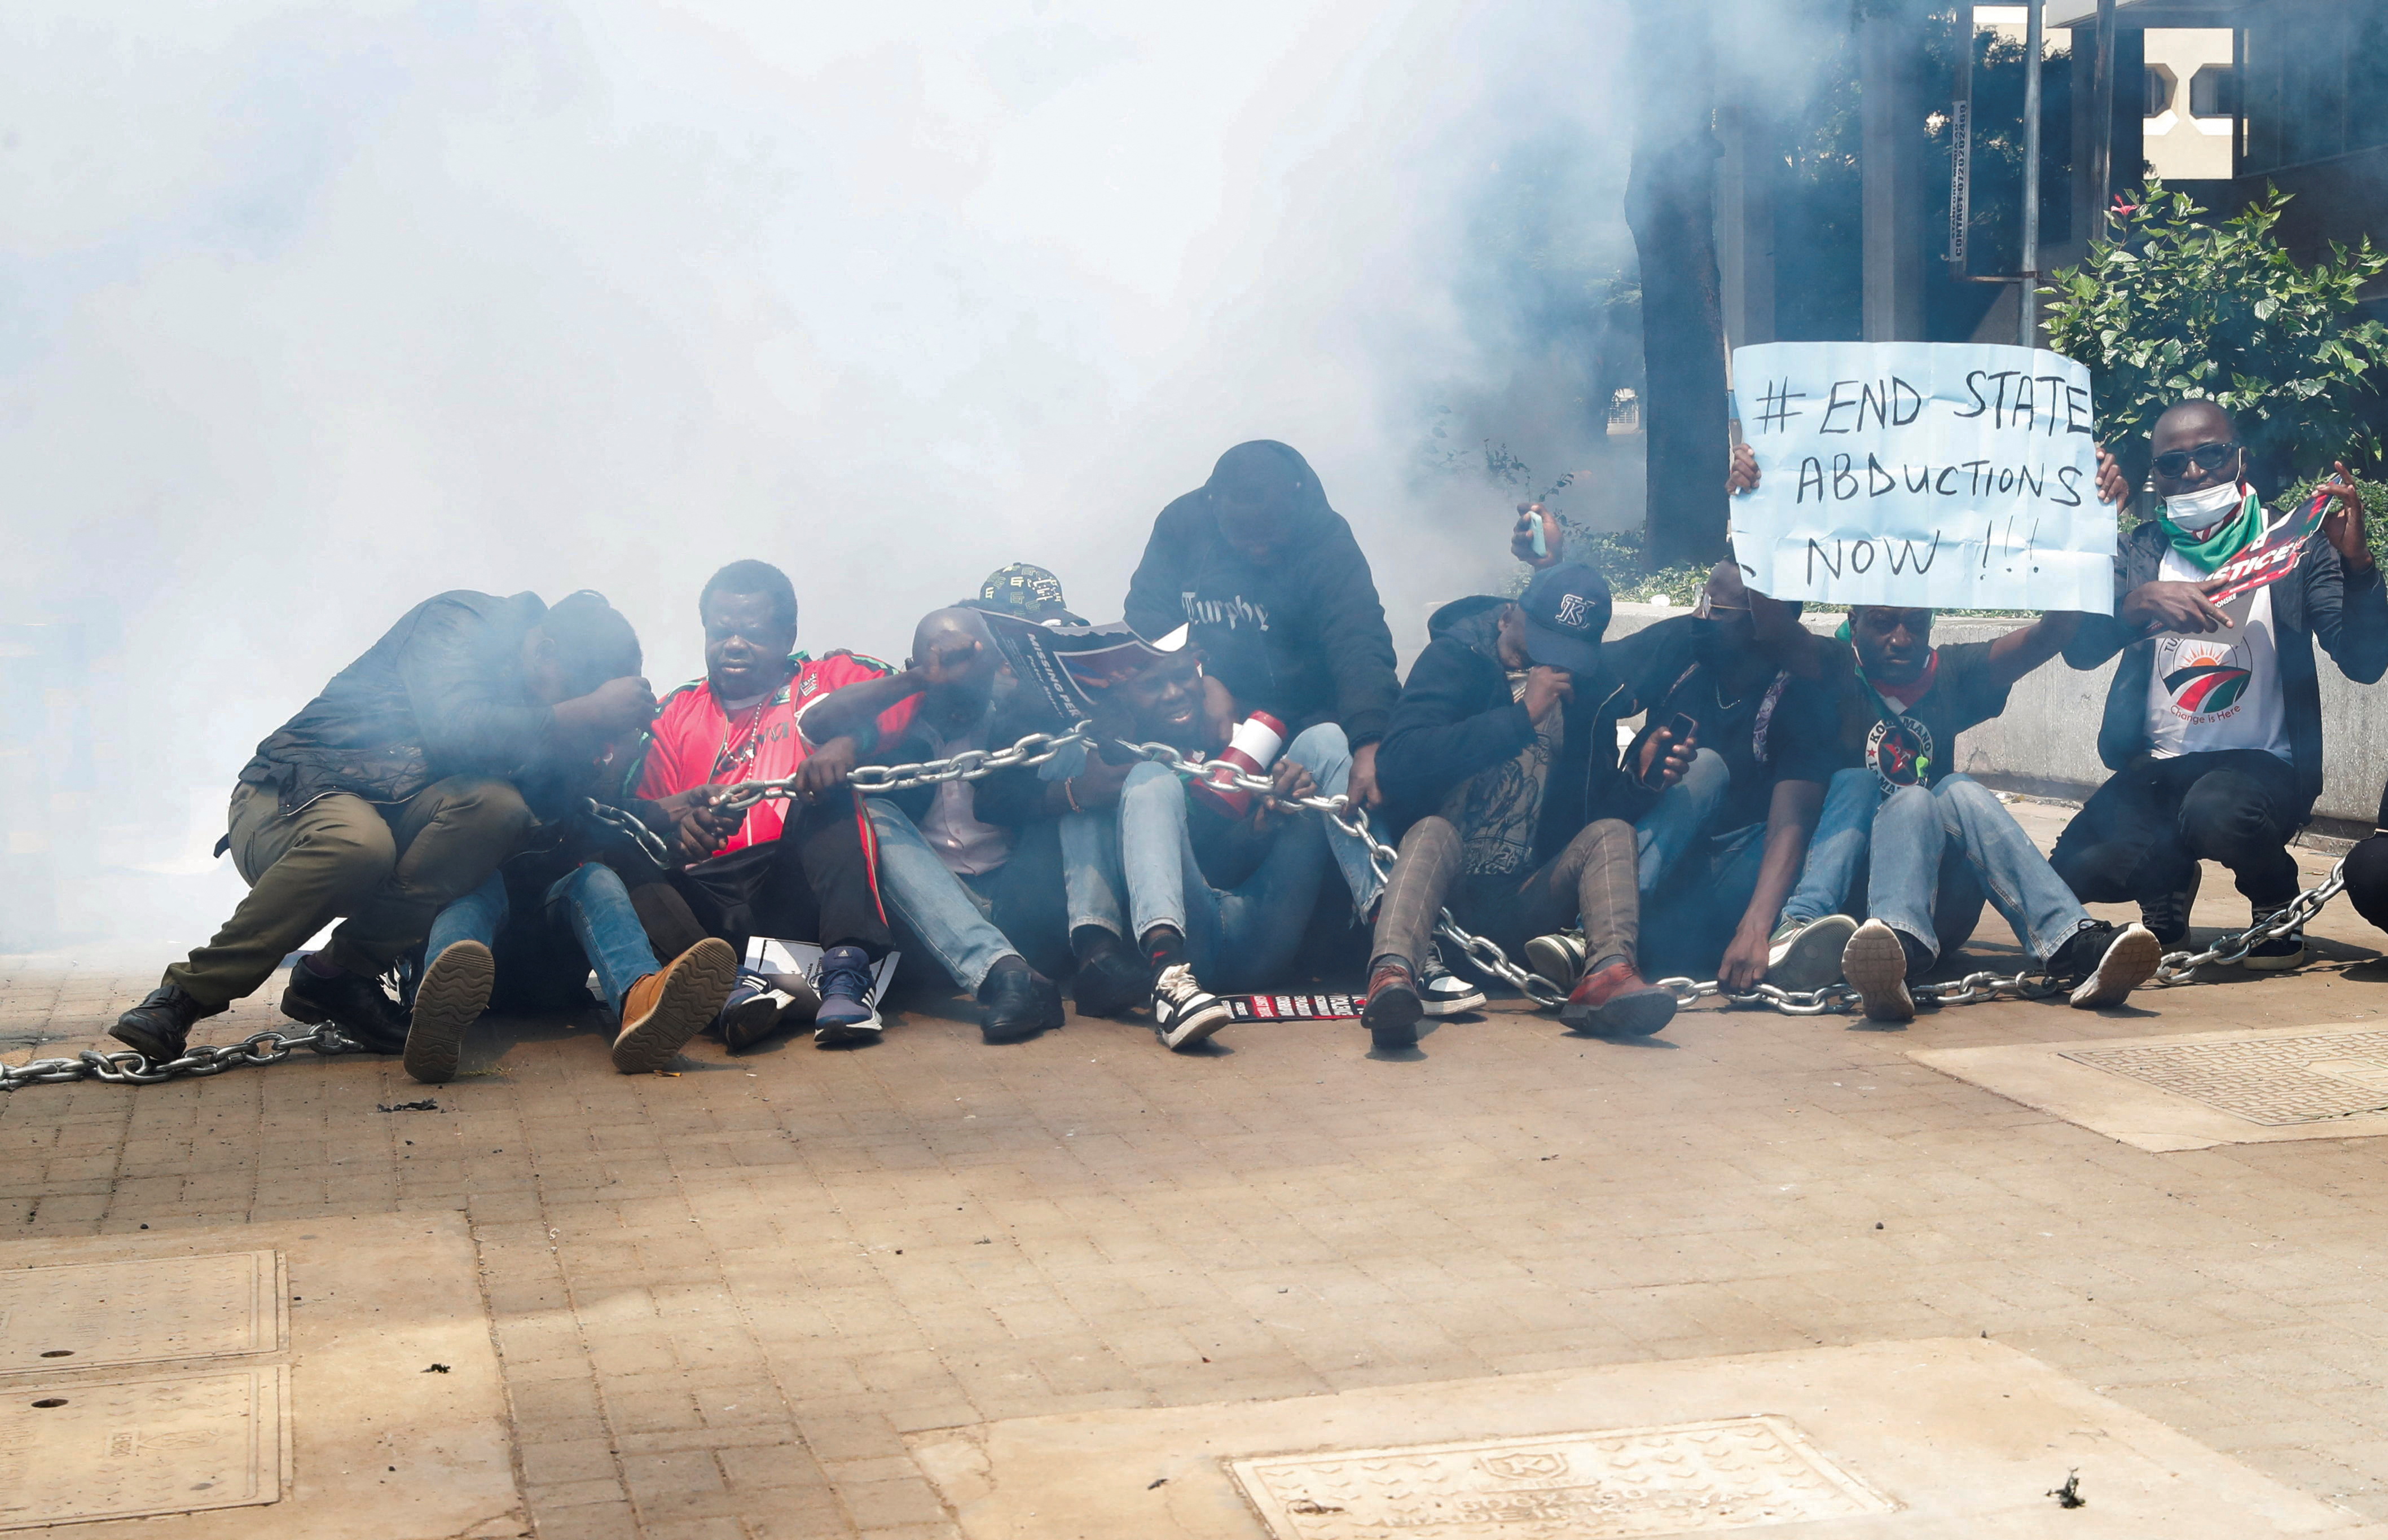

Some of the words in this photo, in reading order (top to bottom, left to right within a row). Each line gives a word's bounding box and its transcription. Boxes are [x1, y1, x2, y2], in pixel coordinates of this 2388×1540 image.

[1752, 376, 1806, 434] #
[1819, 375, 1922, 434] END
[1954, 370, 2092, 437] STATE
[1797, 452, 2082, 507] ABDUCTIONS
[1806, 529, 1941, 586] NOW
[1978, 515, 2040, 581] !!!
[1026, 632, 1065, 693] MISSING
[1058, 694, 1083, 718] PER
[2170, 705, 2205, 725] Change
[2208, 714, 2215, 723] is
[2217, 705, 2241, 721] Here
